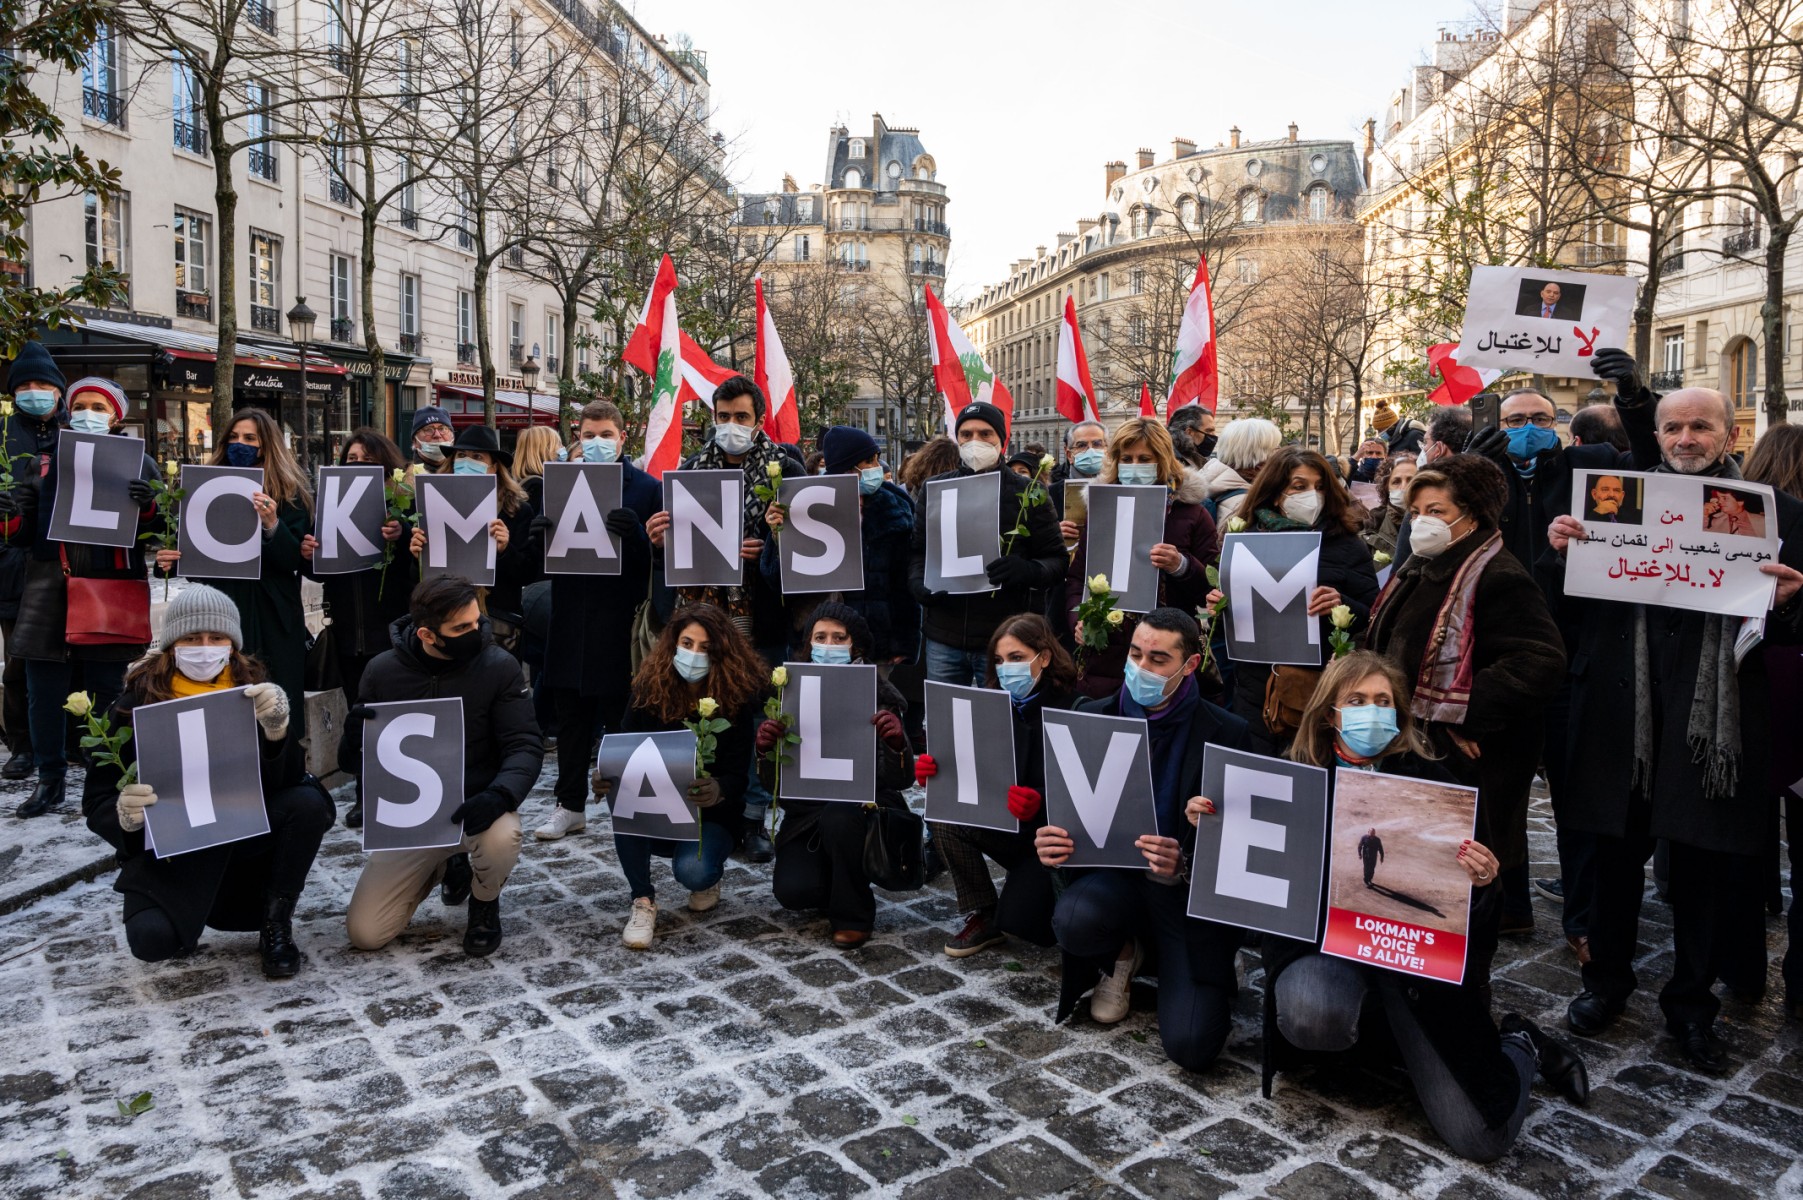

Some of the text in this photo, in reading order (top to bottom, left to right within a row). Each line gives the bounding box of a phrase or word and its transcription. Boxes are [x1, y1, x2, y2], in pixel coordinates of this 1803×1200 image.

[185, 370, 198, 380] Bar
[1477, 325, 1601, 359] لا للإغتيال
[69, 440, 120, 530] L
[185, 475, 262, 563] O
[320, 476, 383, 559] K
[423, 482, 497, 570] M
[547, 469, 618, 559] A
[672, 479, 740, 571] N
[1660, 510, 1684, 525] من
[790, 485, 846, 576] S
[940, 487, 985, 578] L
[1611, 533, 1648, 548] لقمان
[1651, 537, 1674, 554] إلى
[1679, 541, 1721, 556] شعيب
[1725, 550, 1772, 562] موسى
[1229, 541, 1321, 644] M
[375, 712, 444, 828] S
[799, 675, 854, 782] L
[611, 736, 696, 824] A
[1043, 721, 1143, 849] V
[1214, 763, 1294, 909] E
[1355, 917, 1435, 945] LOKMAN'S
[1357, 944, 1425, 970] IS ALIVE!
[1370, 934, 1417, 955] VOICE
